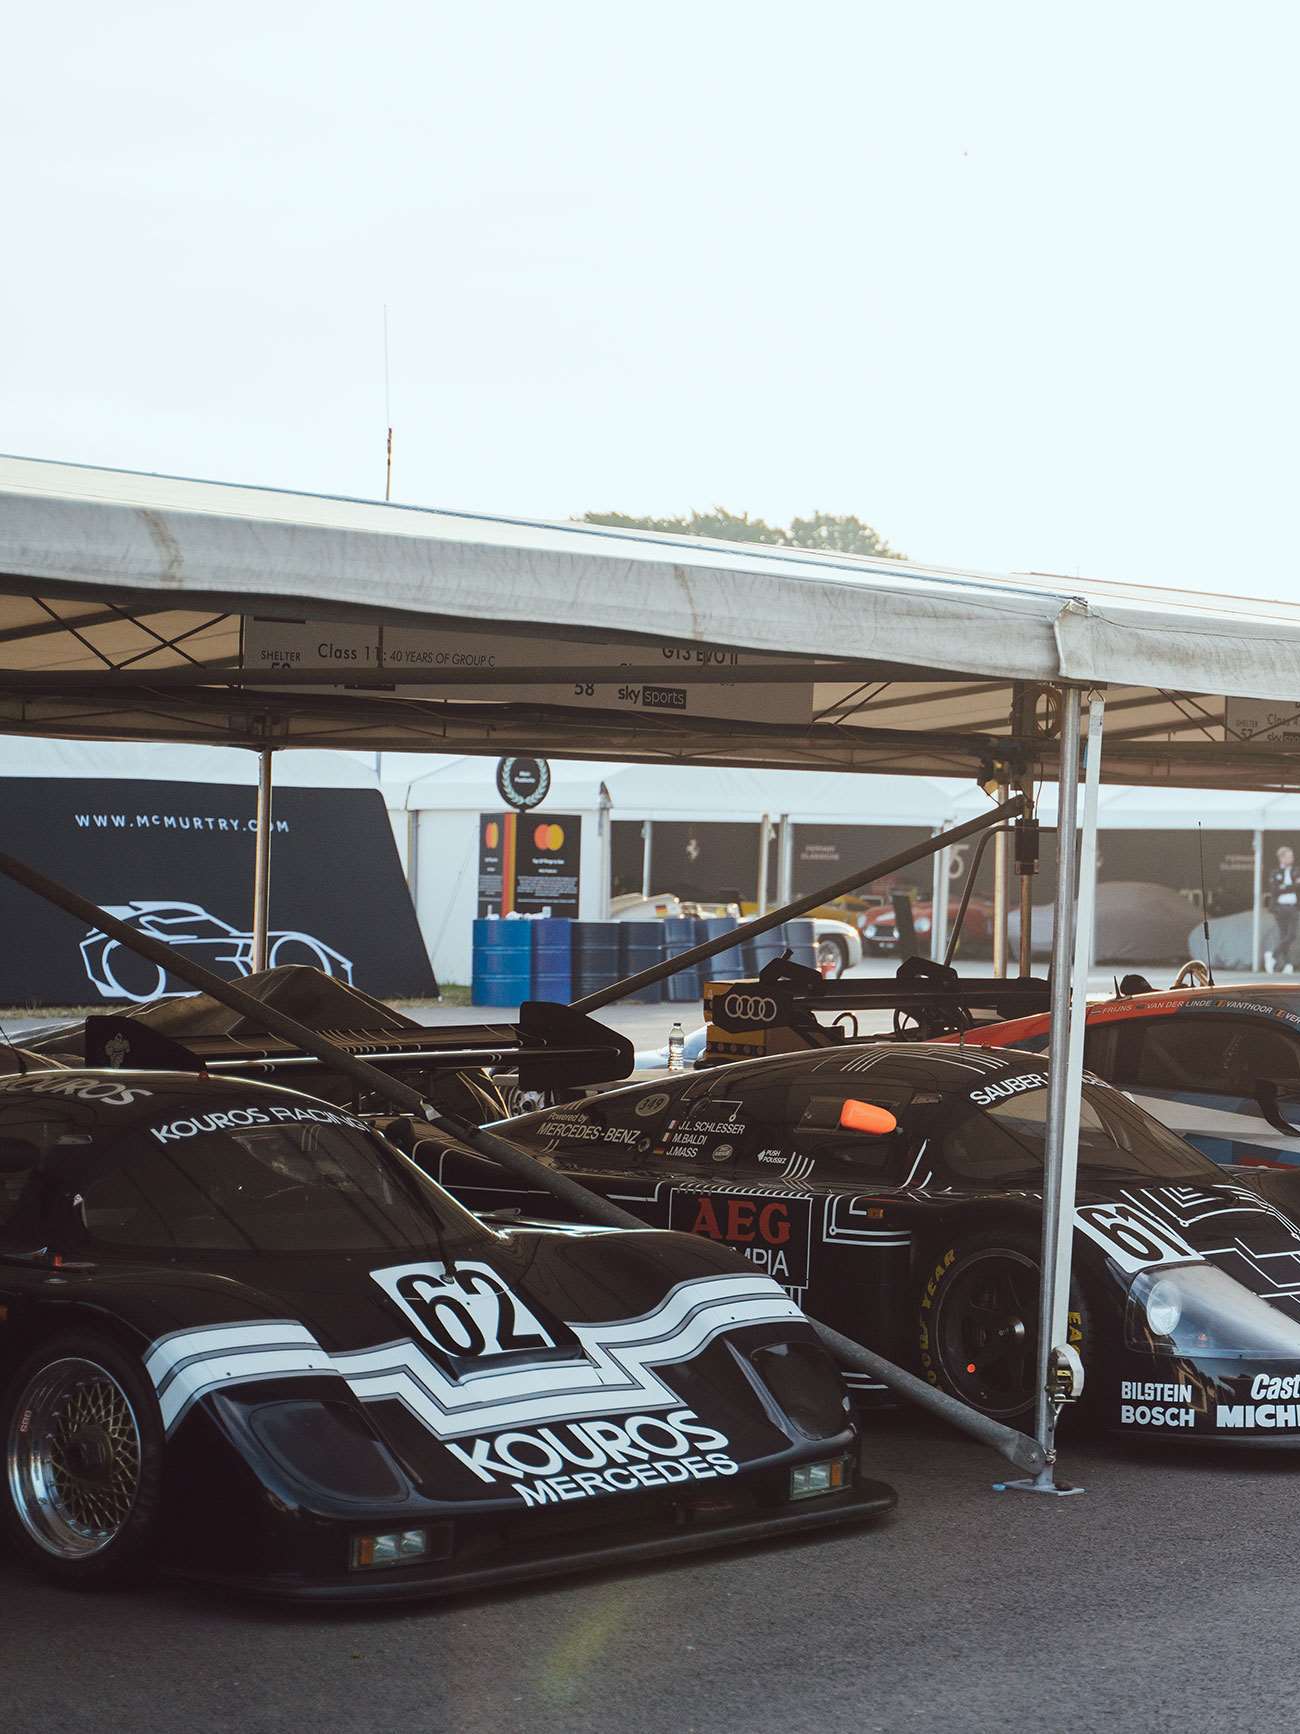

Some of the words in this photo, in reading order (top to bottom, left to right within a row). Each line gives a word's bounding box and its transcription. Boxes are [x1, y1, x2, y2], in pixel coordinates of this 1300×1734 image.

[261, 650, 301, 662] SHELTER
[318, 643, 357, 660] Class
[390, 651, 402, 662] 40
[405, 651, 433, 663] YEARS
[435, 652, 449, 664] OF
[452, 653, 486, 666] GROUP
[618, 685, 640, 704] sky
[644, 689, 684, 706] sports
[75, 814, 289, 833] WWW.McMURTRY.CM
[1166, 1001, 1183, 1009] DER
[1185, 1000, 1211, 1008] LINDE
[1225, 1001, 1273, 1014] VANTHOOR
[970, 1073, 1048, 1105] SAUBER
[150, 1107, 270, 1144] KOUROS
[271, 1107, 372, 1133] RACING
[549, 1112, 577, 1123] Powered
[578, 1114, 588, 1125] by
[693, 1121, 746, 1135] SCHLESSER
[536, 1123, 641, 1145] MERCEDES-BENZ
[672, 1133, 708, 1145] M.BALDI
[666, 1146, 698, 1158] J.MASS
[690, 1199, 793, 1244] AEG
[1076, 1206, 1192, 1261] 61
[396, 1270, 548, 1357] 62
[1121, 1380, 1192, 1403] BILSTEIN
[1121, 1404, 1195, 1427] BOSCH
[444, 1410, 730, 1484] KOUROS
[511, 1453, 739, 1507] MERCEDES
